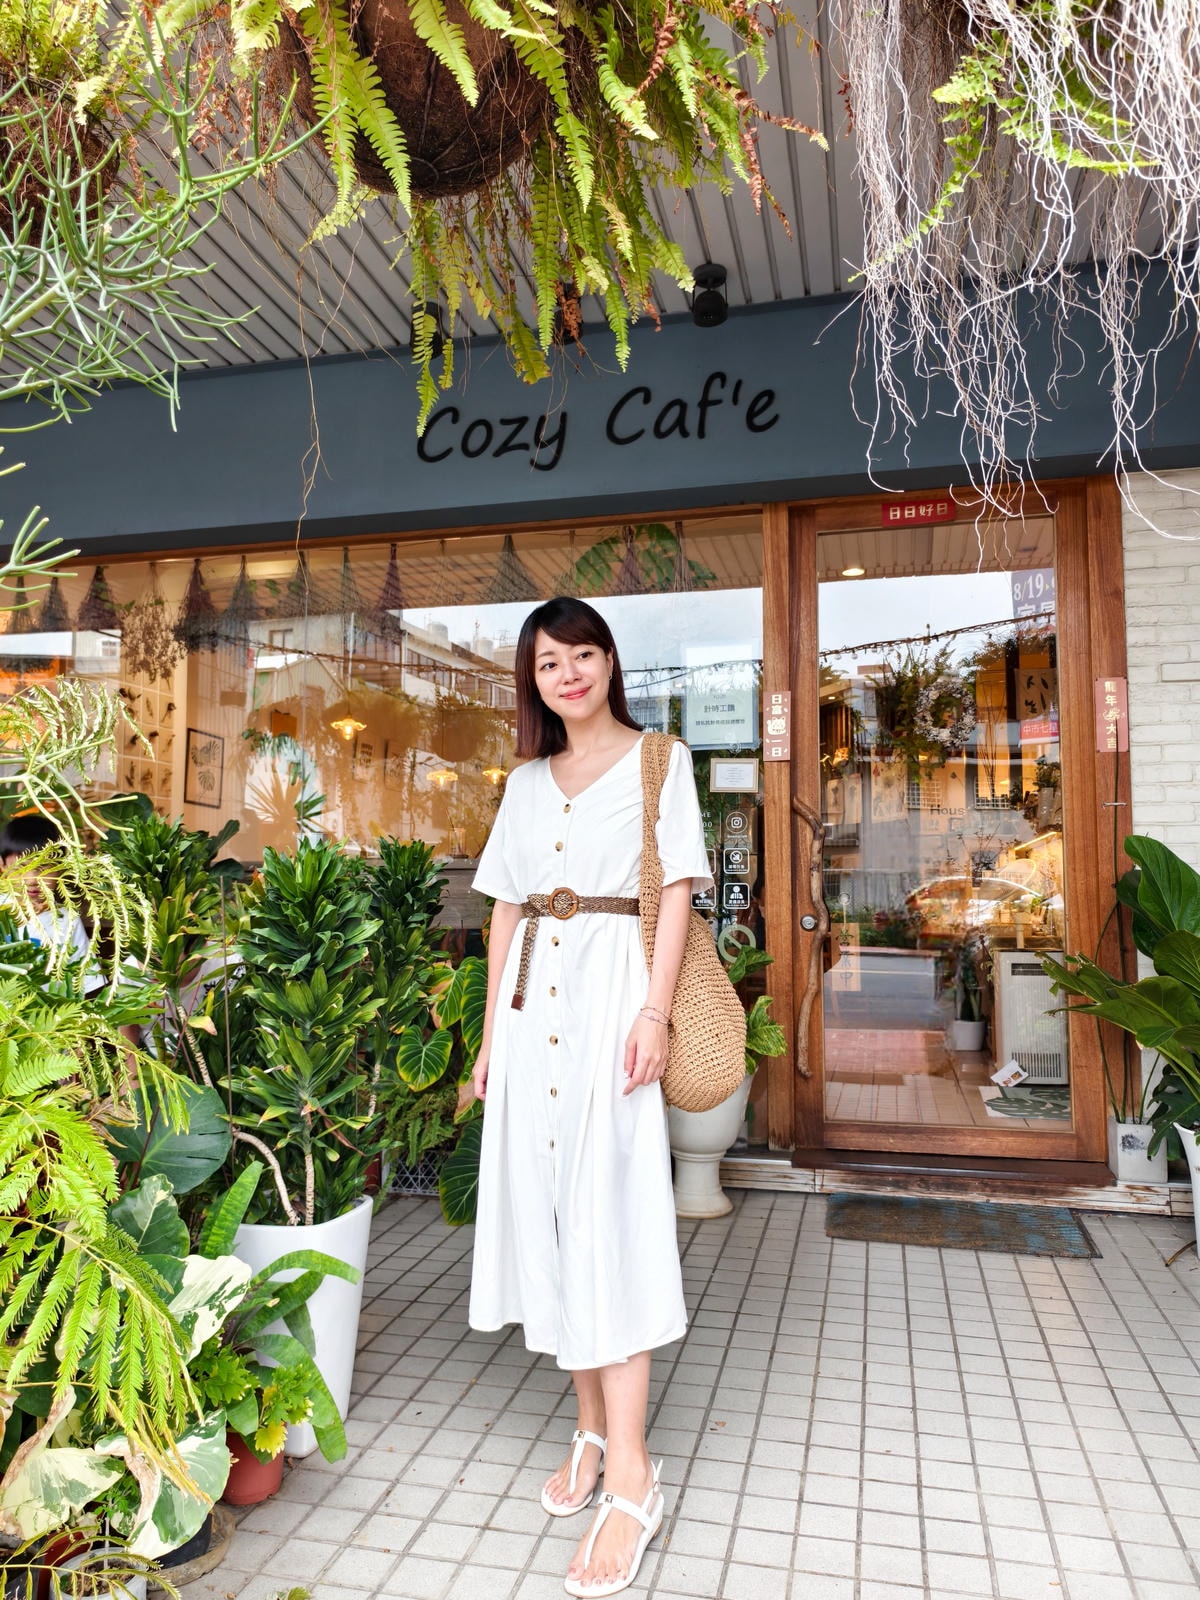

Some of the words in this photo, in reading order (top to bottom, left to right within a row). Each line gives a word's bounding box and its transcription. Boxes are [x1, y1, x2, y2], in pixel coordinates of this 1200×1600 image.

[416, 406, 568, 471] Cozy
[889, 502, 948, 520] 日日好日
[1013, 573, 1044, 602] 8/19
